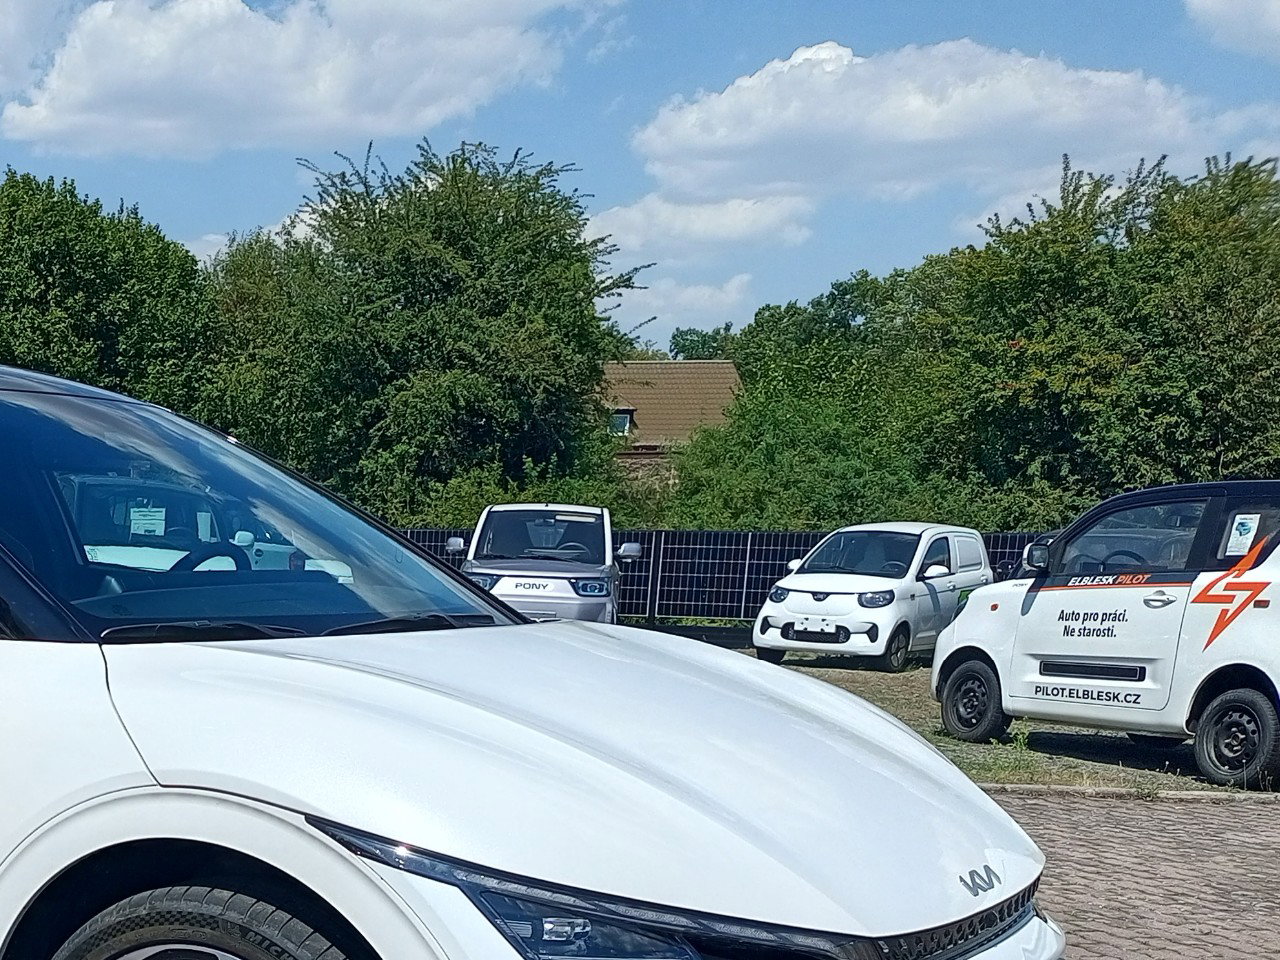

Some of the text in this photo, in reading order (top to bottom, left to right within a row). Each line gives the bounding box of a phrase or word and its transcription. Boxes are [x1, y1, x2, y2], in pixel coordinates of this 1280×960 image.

[515, 582, 549, 590] PONY
[1068, 574, 1152, 586] ELBLESK PILOT
[1058, 609, 1128, 625] Auto pro práci.
[1063, 625, 1117, 637] Ne starosti.
[1035, 685, 1141, 704] PILOT.ELBLESK.CZ
